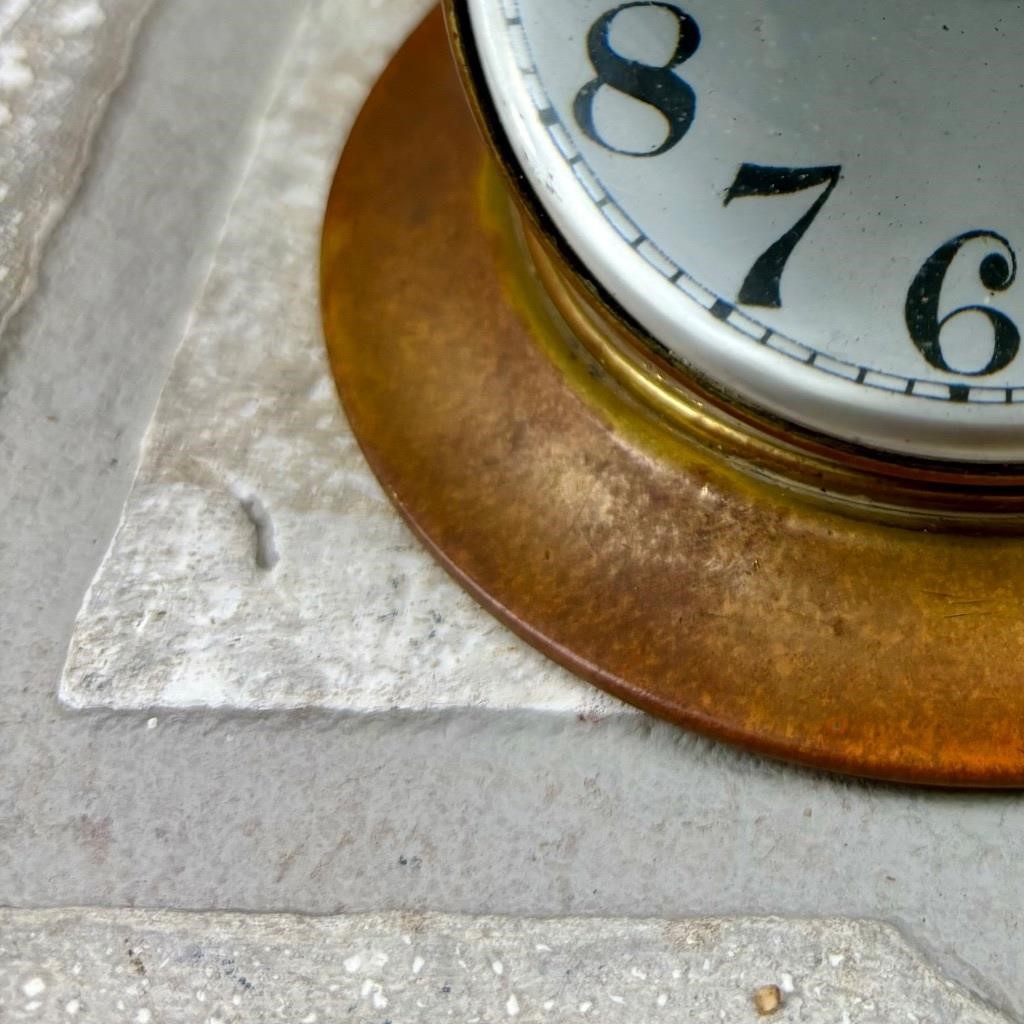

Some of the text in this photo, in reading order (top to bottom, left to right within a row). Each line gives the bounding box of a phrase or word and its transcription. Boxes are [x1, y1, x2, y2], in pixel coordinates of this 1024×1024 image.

[572, 1, 702, 158] 8
[723, 163, 843, 309] 7
[905, 229, 1021, 377] 6
